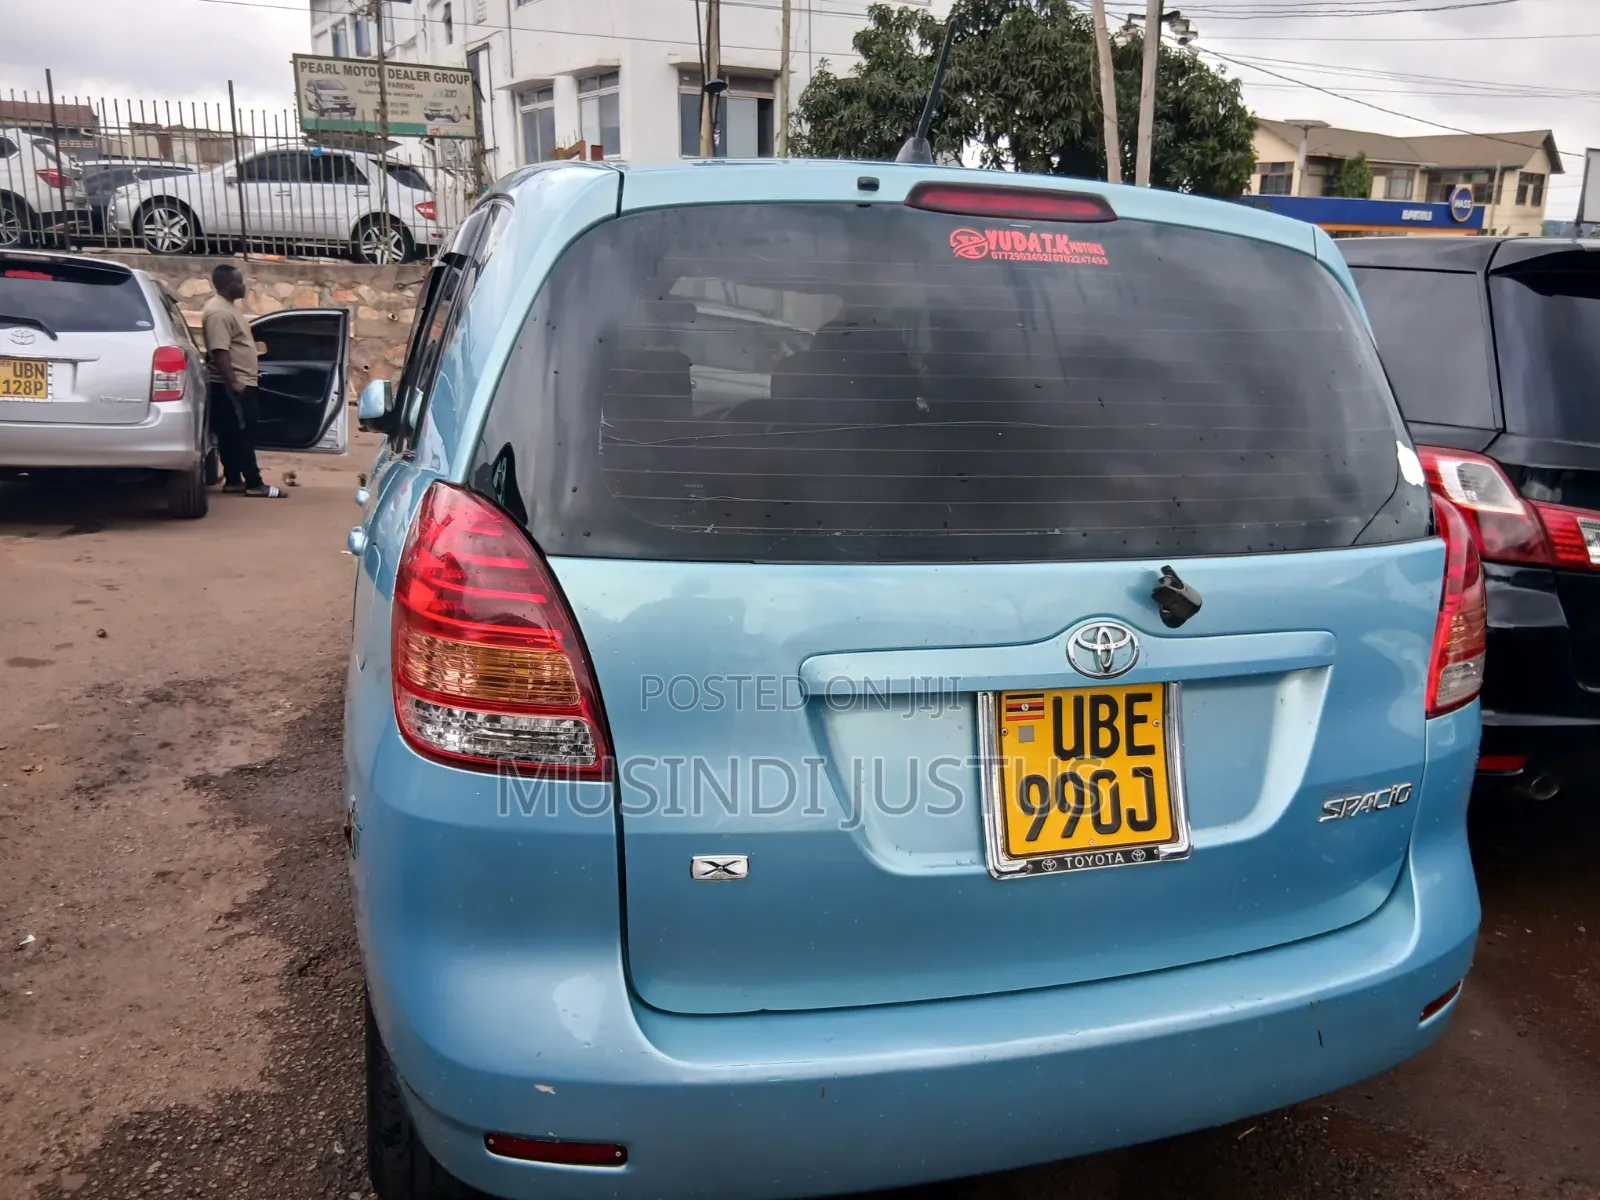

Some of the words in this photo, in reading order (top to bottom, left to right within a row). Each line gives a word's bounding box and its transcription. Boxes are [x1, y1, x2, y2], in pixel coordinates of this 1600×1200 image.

[301, 61, 340, 75] PEARL
[343, 64, 381, 78] MOTO
[388, 68, 431, 83] DEALER
[434, 72, 471, 85] GROUP
[387, 81, 415, 90] PARKING
[1069, 242, 1105, 255] MOTORS
[13, 361, 46, 380] UBN
[2, 379, 44, 396] 128P
[1052, 692, 1156, 761] UBE
[1018, 766, 1158, 842] 990J
[1064, 852, 1125, 869] TOYOTA
